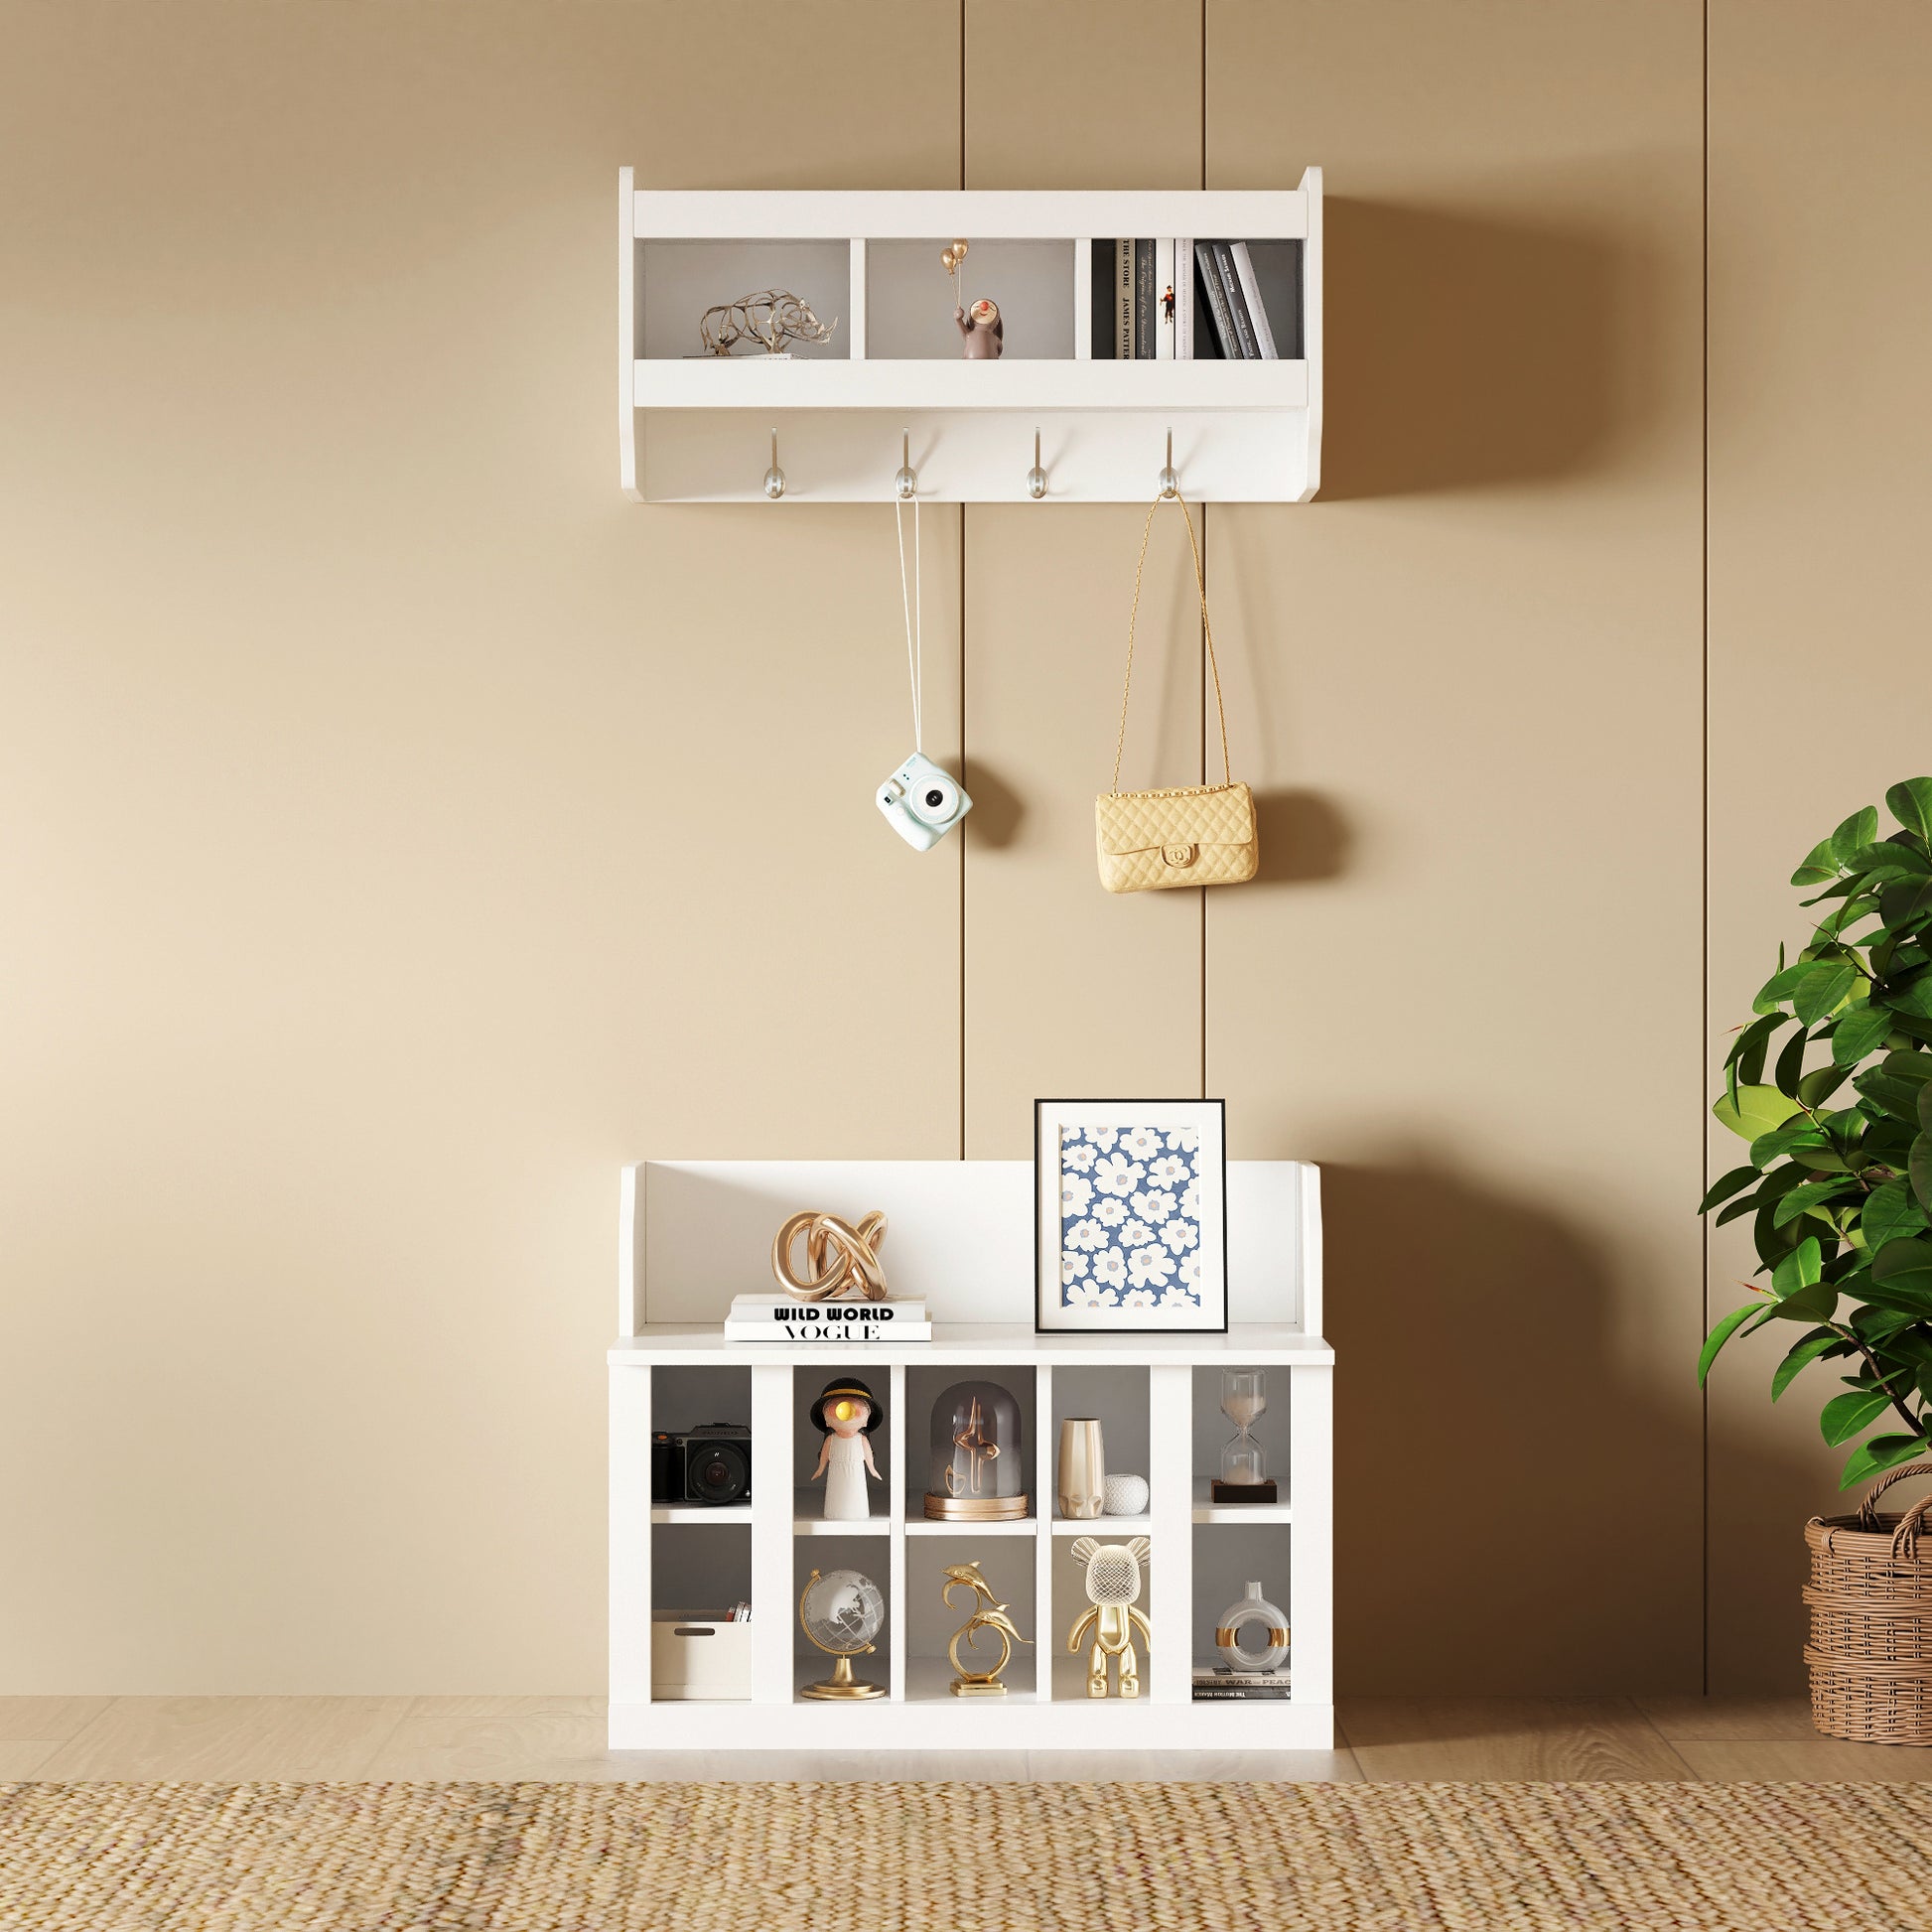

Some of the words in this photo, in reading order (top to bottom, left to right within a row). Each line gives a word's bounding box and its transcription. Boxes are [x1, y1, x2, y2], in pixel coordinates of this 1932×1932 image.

[774, 1308, 819, 1320] WILD
[827, 1308, 894, 1320] WORLD
[784, 1325, 881, 1339] VOGUE
